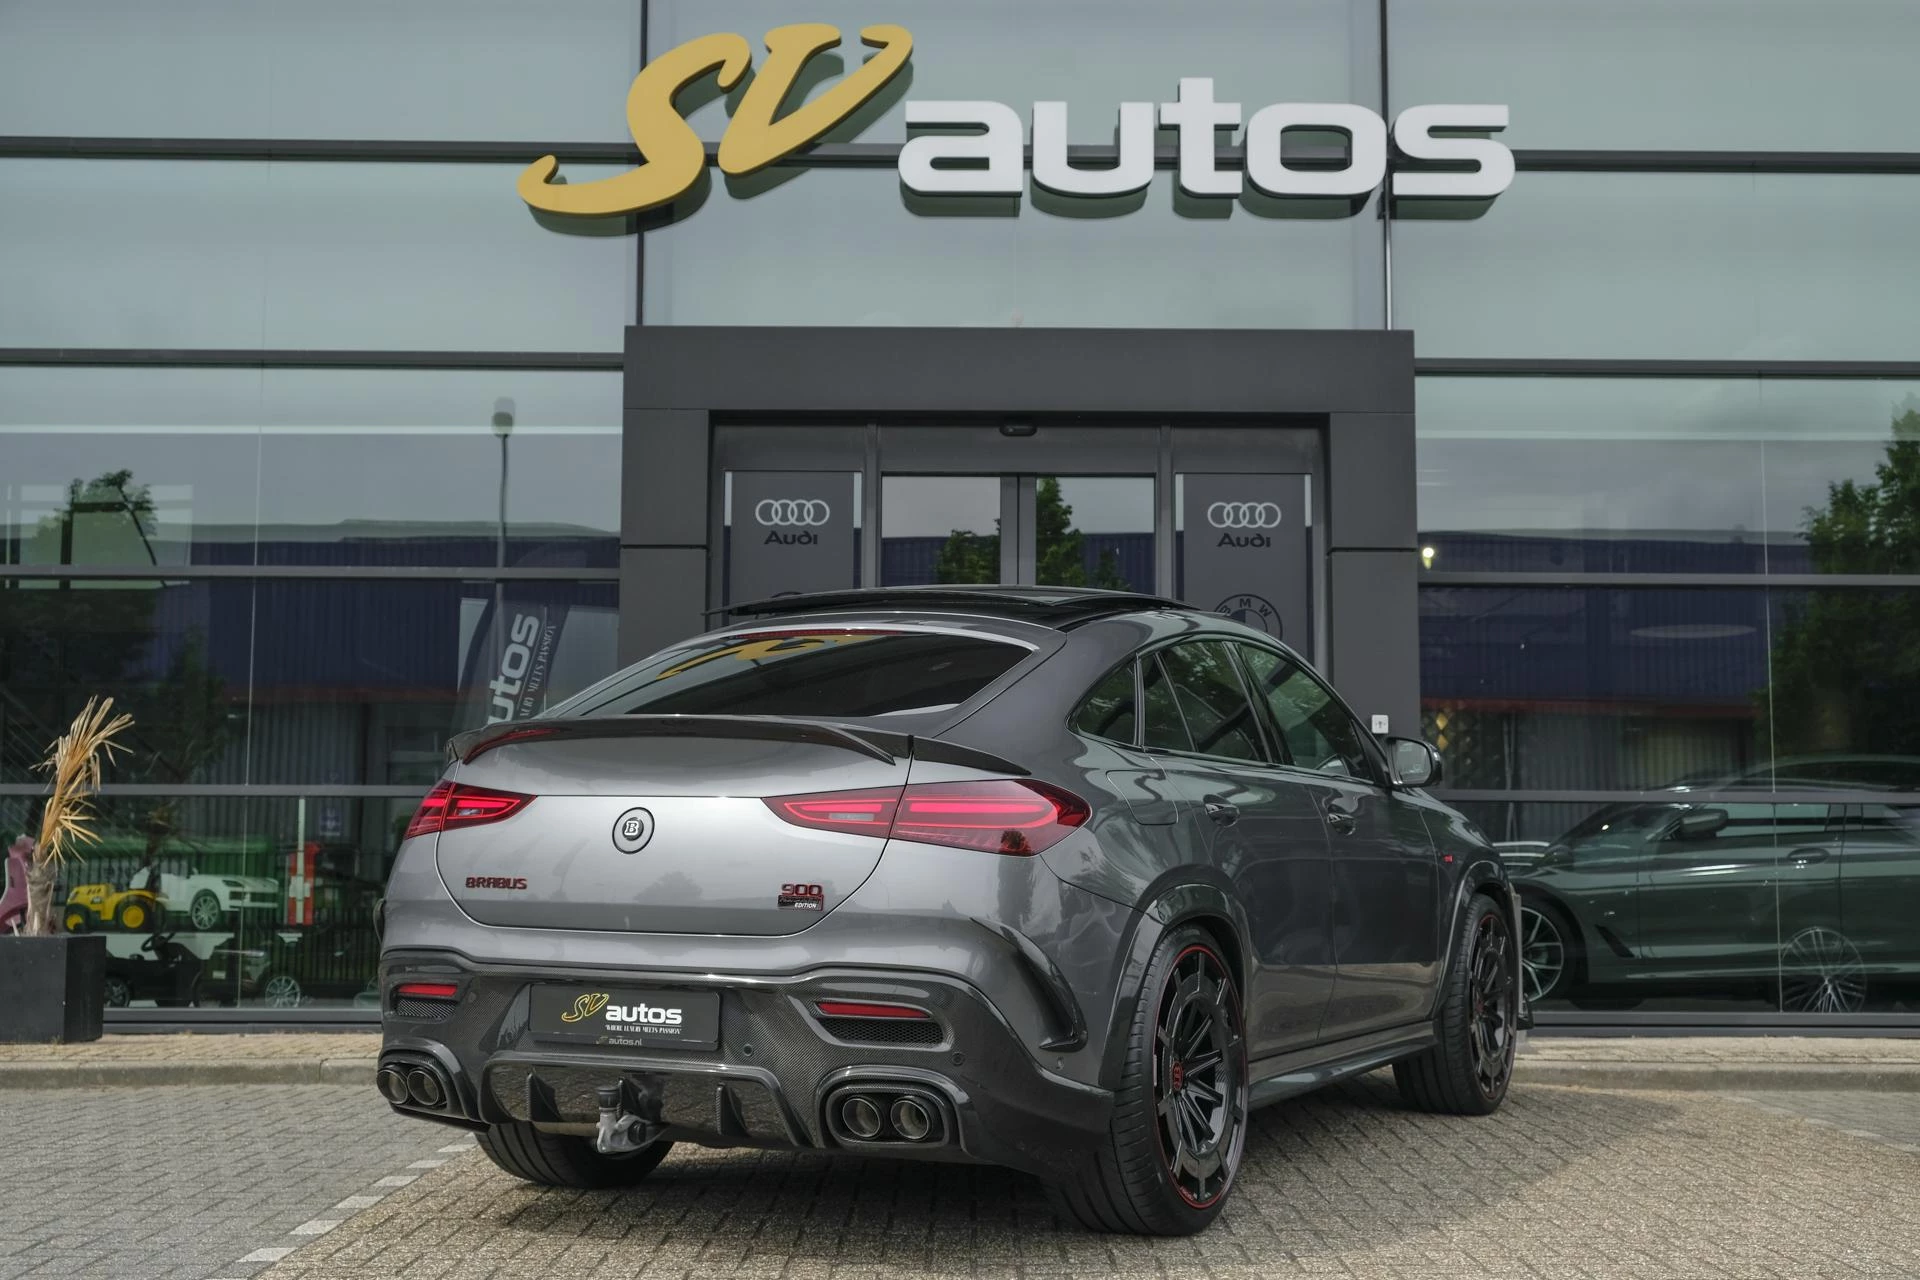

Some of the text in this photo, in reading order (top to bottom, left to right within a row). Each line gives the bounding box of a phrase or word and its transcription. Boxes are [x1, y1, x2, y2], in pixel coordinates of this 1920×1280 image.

[518, 23, 1516, 217] SV autos
[763, 530, 818, 545] Audi
[1217, 532, 1271, 548] Audi
[1219, 598, 1273, 617] BMW
[487, 613, 540, 725] utos
[465, 876, 528, 890] BRABUS
[781, 883, 823, 897] 900
[561, 993, 683, 1025] SV autos
[608, 1038, 642, 1046] autos.nl
